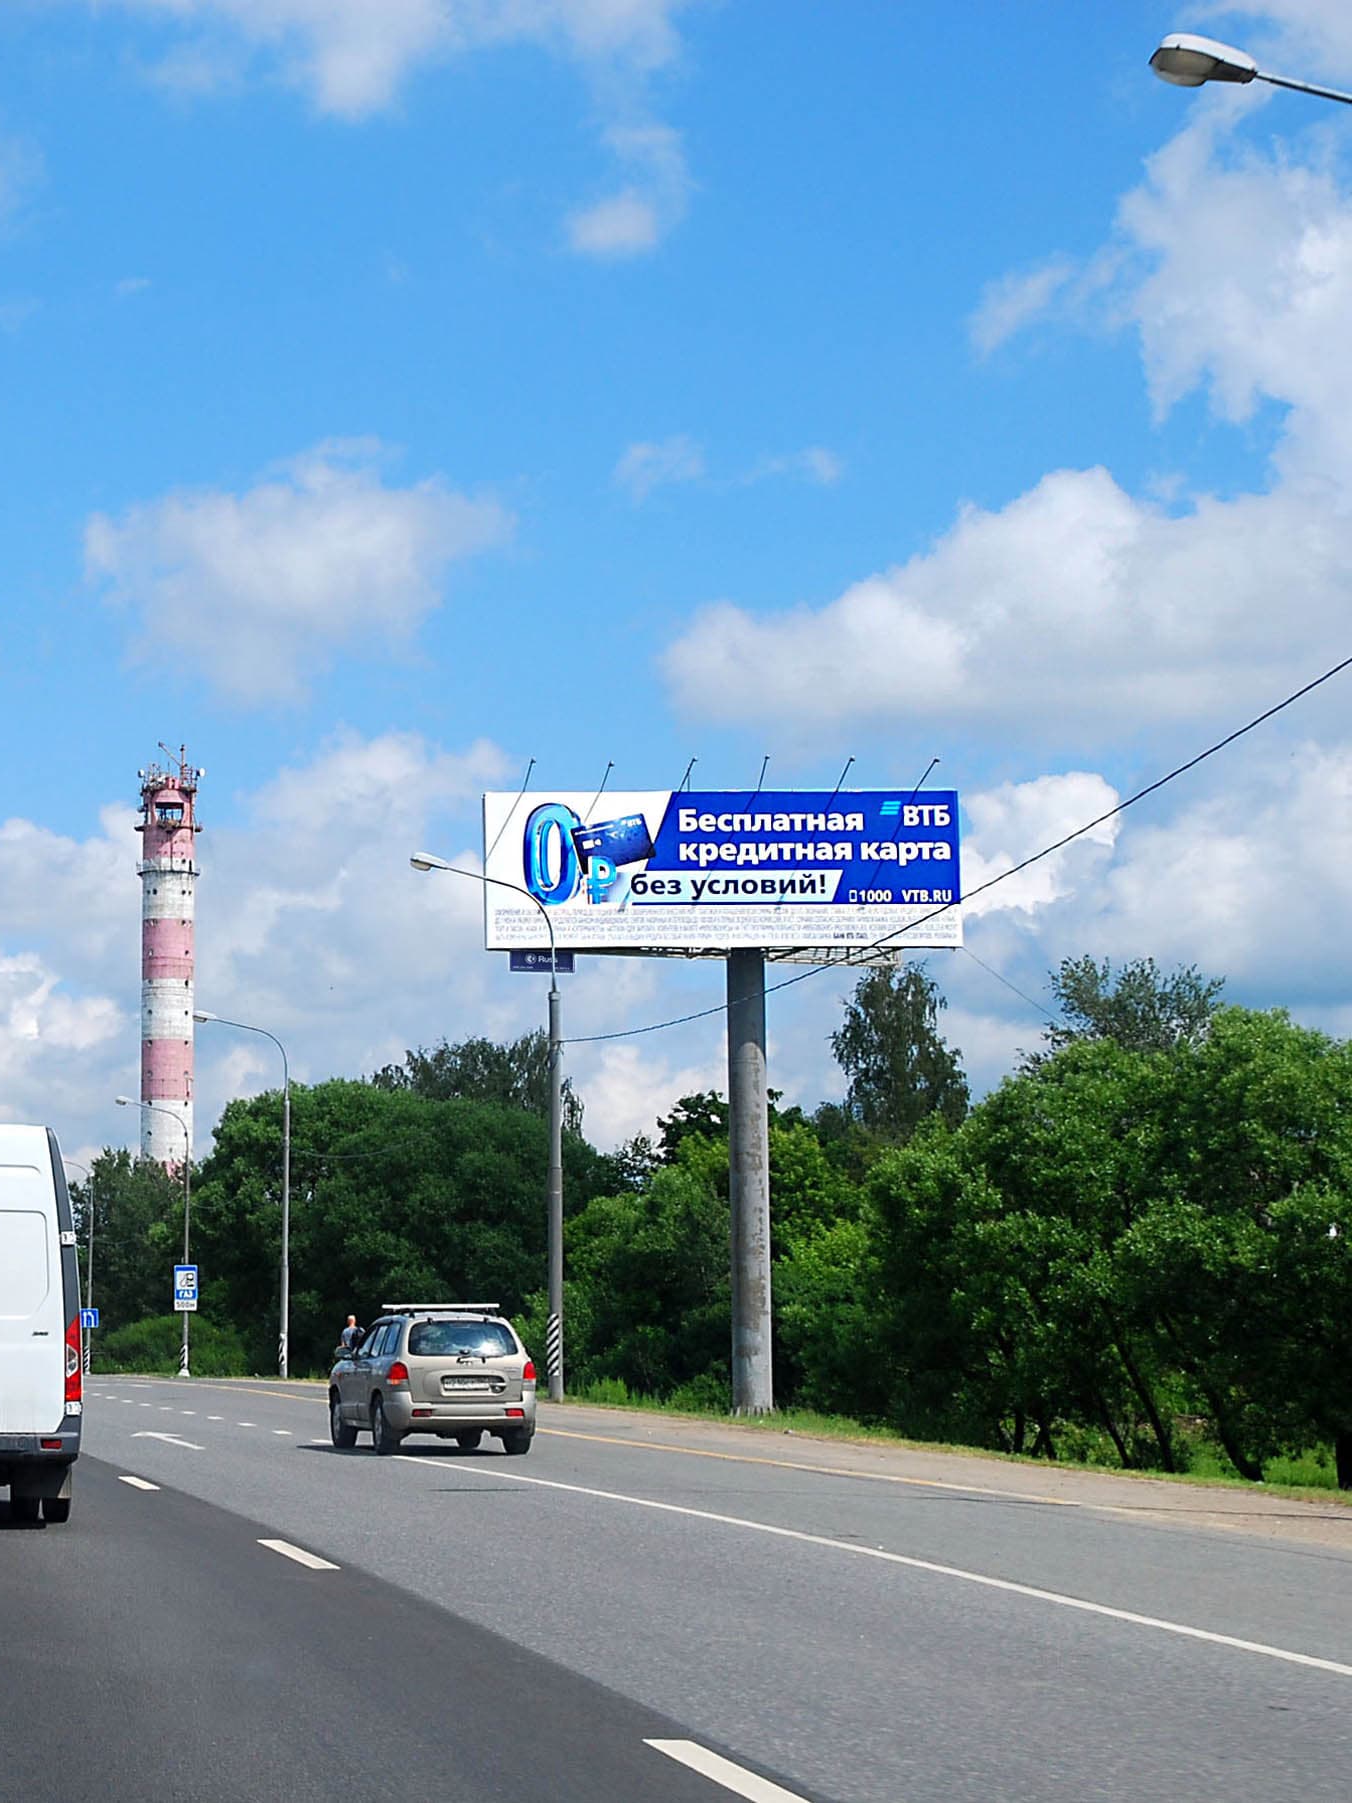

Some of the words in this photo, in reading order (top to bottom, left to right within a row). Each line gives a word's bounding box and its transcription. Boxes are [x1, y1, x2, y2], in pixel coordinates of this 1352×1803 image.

[678, 808, 864, 832] Бесплатная
[903, 804, 951, 826] ВТБ
[679, 842, 853, 867] кредитная
[860, 841, 952, 867] карта
[630, 873, 682, 895] без
[690, 873, 827, 900] условий!
[859, 889, 892, 903] 1000
[901, 889, 952, 903] VTB.RU
[179, 1290, 193, 1299] ГАЗ
